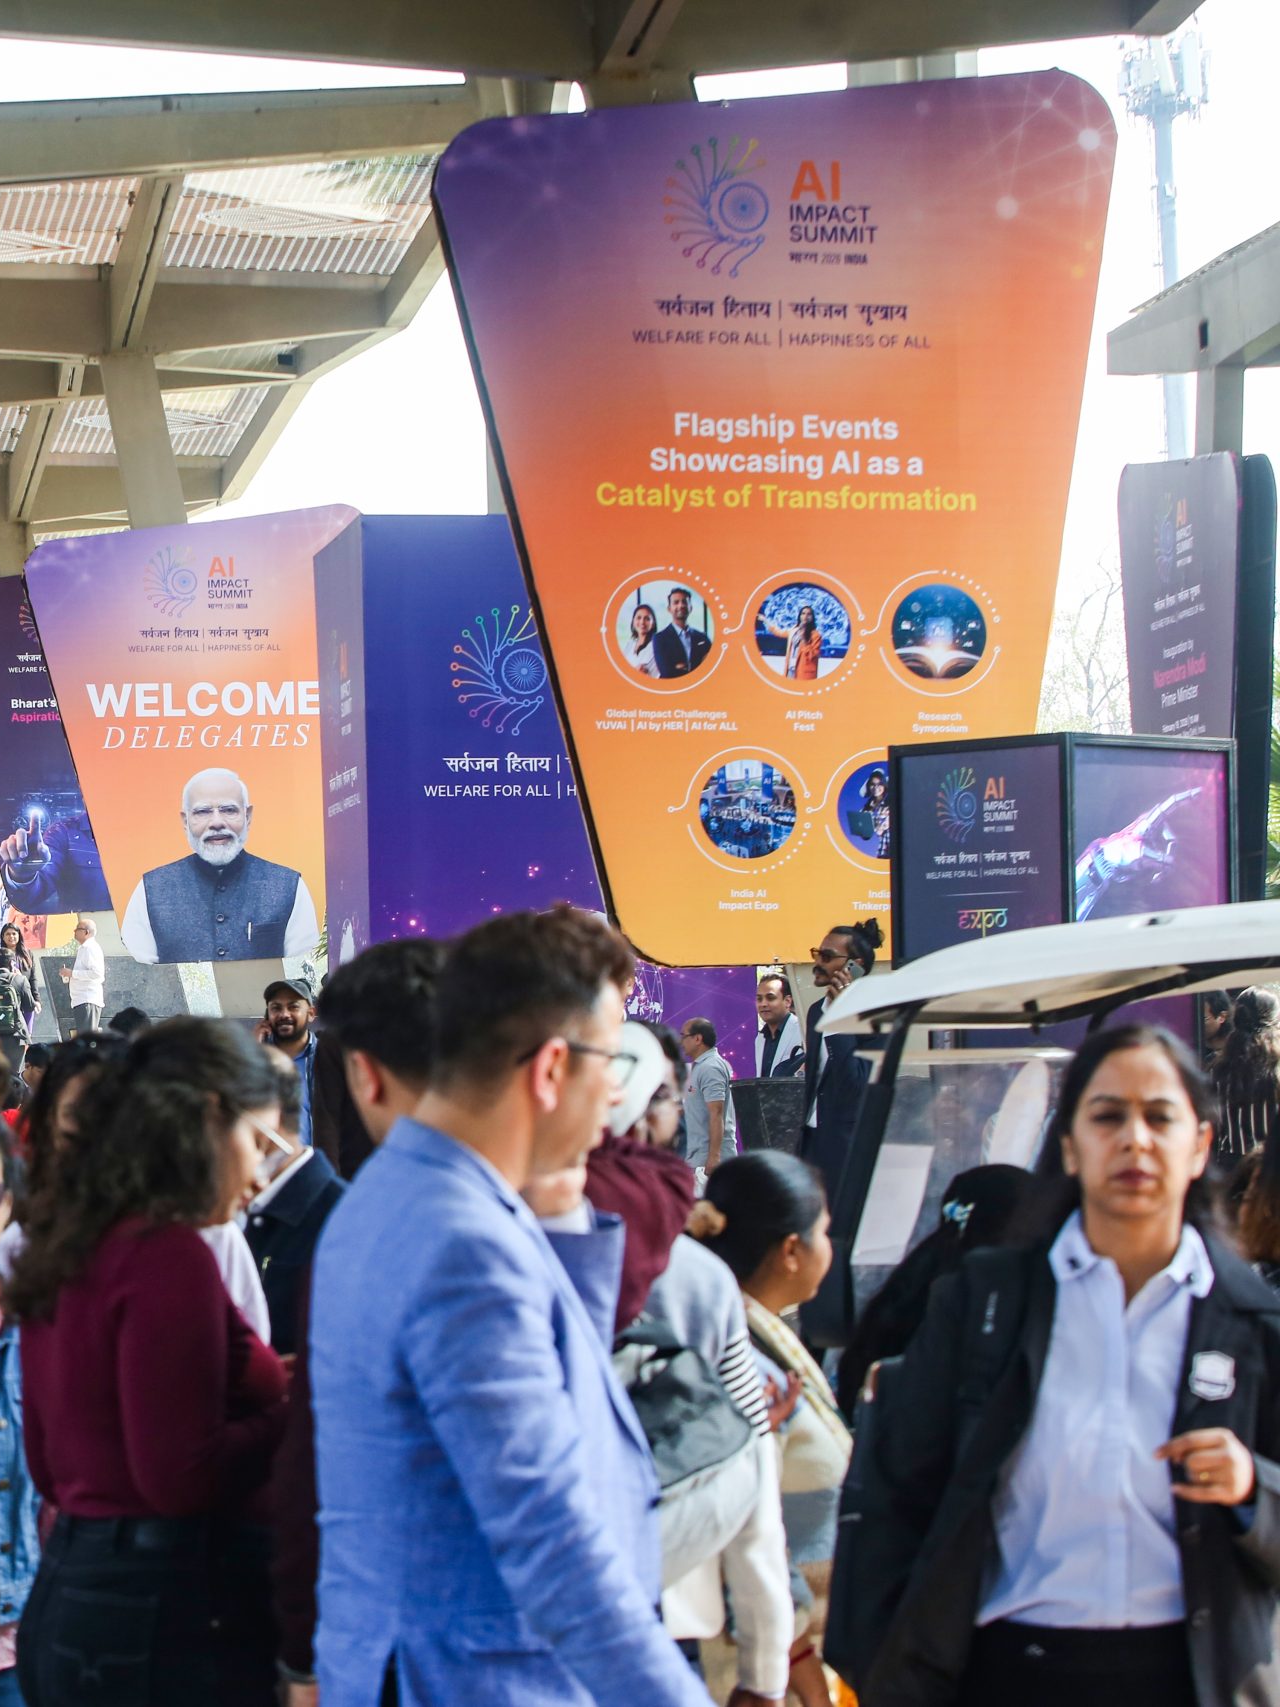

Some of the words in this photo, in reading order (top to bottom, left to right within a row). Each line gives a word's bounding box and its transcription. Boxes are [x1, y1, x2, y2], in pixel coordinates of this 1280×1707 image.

[790, 160, 840, 202] AI
[789, 204, 871, 224] IMPACT
[789, 224, 878, 244] SUMMIT
[722, 294, 772, 319] हिताय
[632, 329, 704, 345] WELFARE
[708, 330, 740, 346] FOR
[743, 330, 772, 346] ALL
[788, 333, 874, 348] HAPPINESS
[878, 334, 900, 349] OF
[903, 334, 931, 350] ALL
[673, 412, 795, 443] Flagship
[801, 414, 899, 441] Events
[649, 447, 824, 479] Showcasing
[830, 450, 861, 475] AI
[866, 456, 901, 476] as
[905, 456, 924, 476] a
[595, 481, 716, 512] Catalyst
[722, 483, 753, 508] of
[758, 484, 978, 512] Transformation
[209, 556, 234, 577] AI
[207, 579, 249, 588] IMPACT
[208, 589, 253, 599] SUMMIT
[174, 627, 198, 638] हिताय
[128, 645, 164, 653] WELFARE
[168, 645, 182, 653] FOR
[184, 644, 198, 652] ALL
[208, 644, 251, 652] HAPPINESS
[267, 643, 280, 651] ALL
[10, 698, 57, 709] Bharat's
[86, 681, 320, 718] WELCOME
[605, 709, 637, 719] Global
[638, 709, 672, 721] Impact
[674, 710, 728, 720] Challenges
[785, 710, 796, 720] AI
[797, 710, 823, 720] Pitch
[918, 712, 963, 722] Research
[637, 721, 648, 731] AI
[649, 721, 661, 732] by
[663, 721, 684, 731] HER
[691, 721, 702, 731] AI
[703, 721, 718, 731] for
[720, 721, 738, 732] ALL
[793, 722, 816, 732] Fest
[911, 723, 968, 734] Symposium
[102, 723, 311, 749] DELEGATES
[443, 752, 499, 772] सर्वजन
[505, 752, 551, 773] हिताय
[424, 785, 489, 797] WELFARE
[494, 785, 521, 797] FOR
[526, 785, 551, 797] ALL
[984, 776, 1005, 800] AI
[983, 799, 1016, 811] IMPACT
[983, 810, 1019, 822] SUMMIT
[730, 889, 754, 898] India
[756, 889, 767, 898] AI
[718, 901, 752, 912] Impact
[754, 901, 780, 912] Expo
